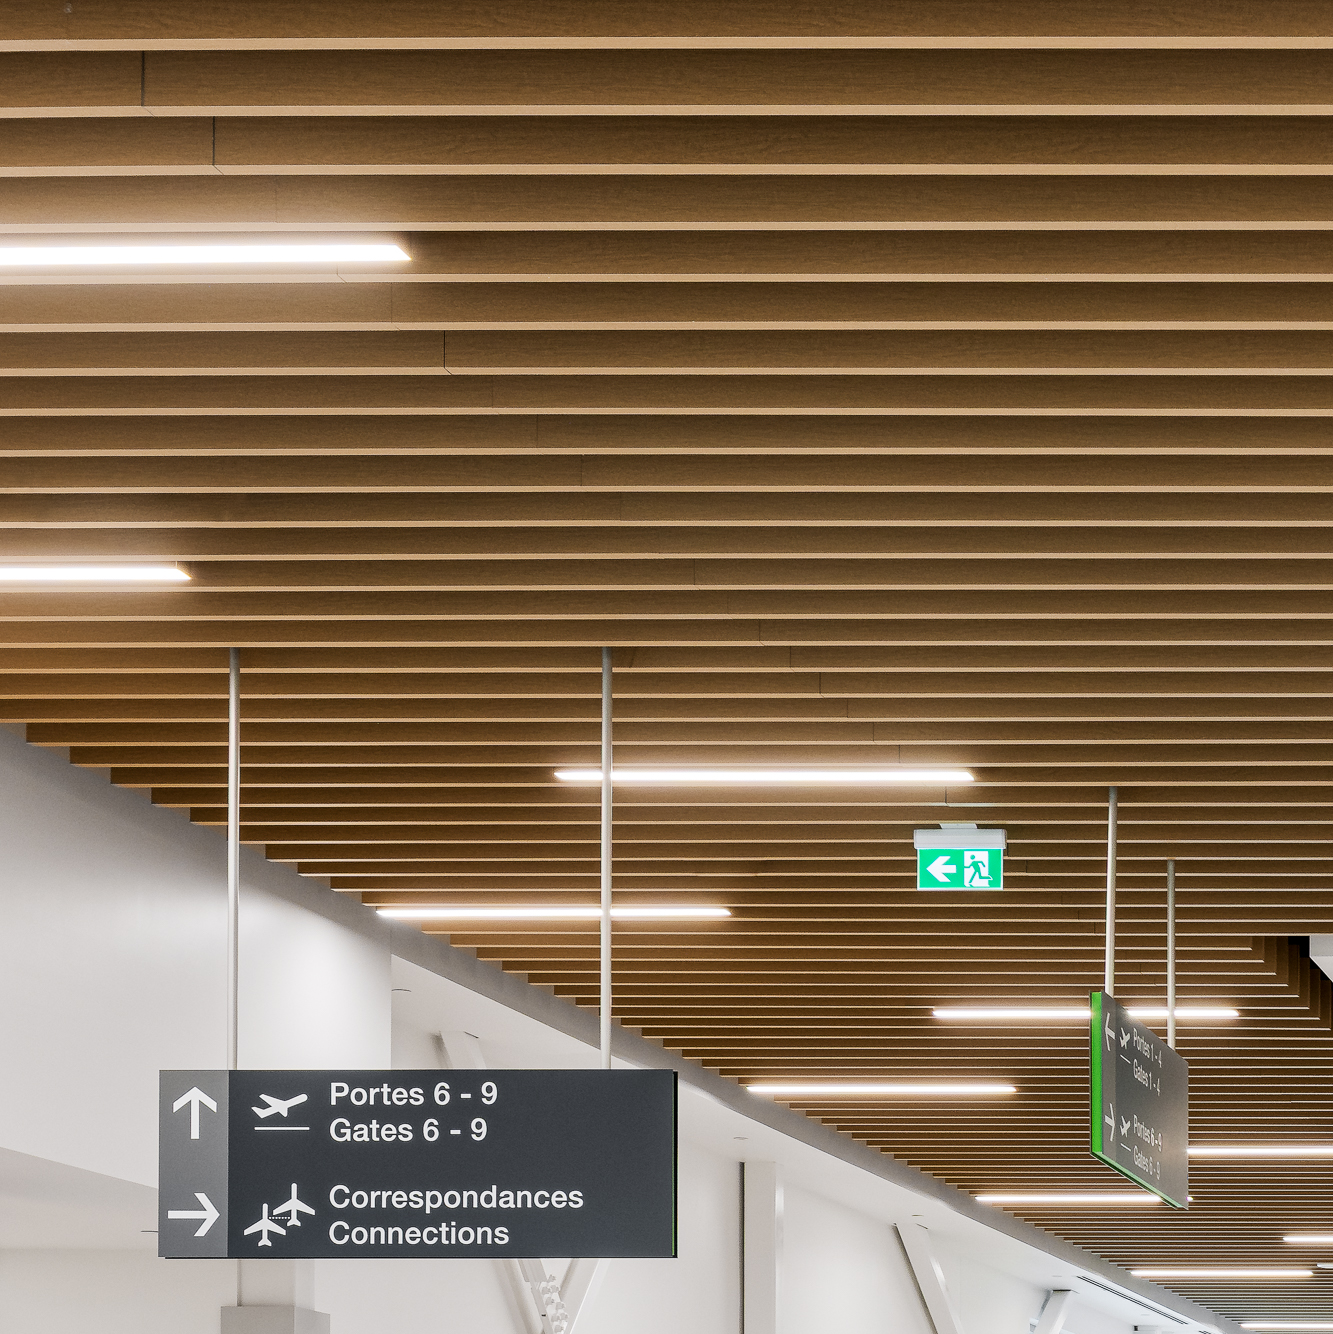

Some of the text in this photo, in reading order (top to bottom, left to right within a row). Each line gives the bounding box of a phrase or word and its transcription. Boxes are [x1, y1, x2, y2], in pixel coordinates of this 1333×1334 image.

[1133, 1028, 1150, 1059] Portes
[1158, 1050, 1162, 1068] 4
[331, 1082, 425, 1106] Portes
[433, 1081, 451, 1106] 6
[481, 1081, 498, 1106] 9
[1133, 1059, 1149, 1087] Gates
[1156, 1078, 1161, 1096] 4
[329, 1117, 414, 1142] Gates
[422, 1118, 440, 1142] 6
[470, 1117, 488, 1142] 9
[1133, 1114, 1151, 1144] Portes
[1150, 1127, 1155, 1147] 6
[1158, 1132, 1162, 1152] 9
[1133, 1145, 1149, 1173] Gates
[1149, 1156, 1153, 1175] 6
[1156, 1161, 1161, 1180] 9
[329, 1184, 584, 1213] Correspondances
[328, 1220, 510, 1245] Connections
